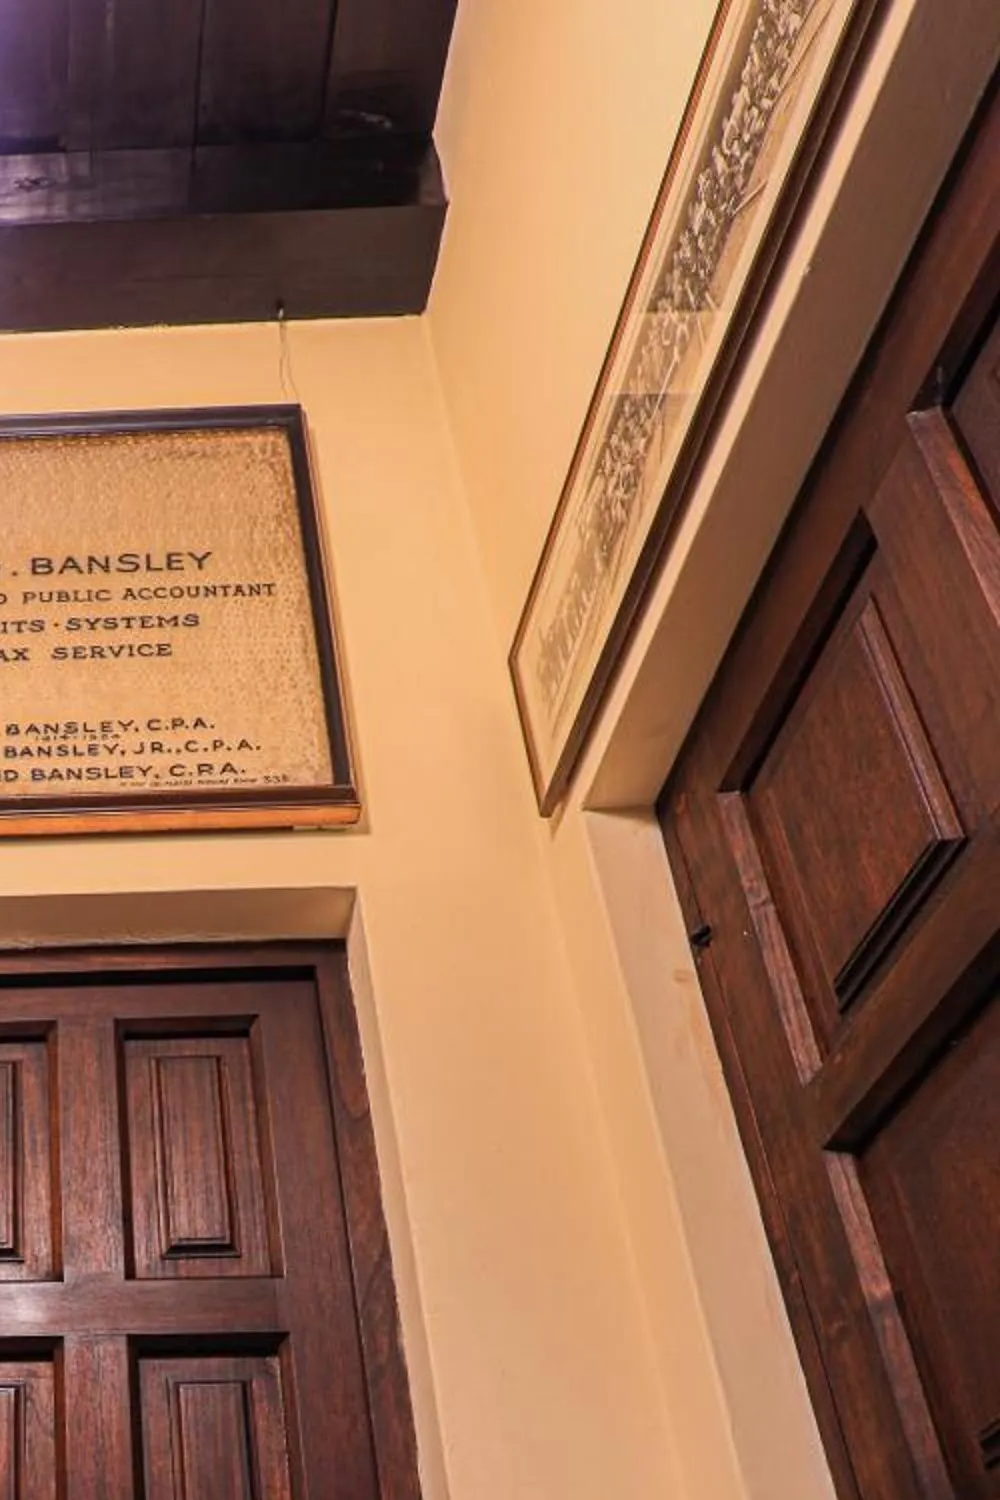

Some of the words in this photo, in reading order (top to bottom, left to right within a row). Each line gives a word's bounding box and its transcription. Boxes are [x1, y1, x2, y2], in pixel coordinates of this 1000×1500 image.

[31, 551, 212, 575] BANSLEY
[22, 589, 112, 604] PUBLIC
[122, 583, 276, 601] ACCOUNTANT
[51, 643, 173, 660] SERVICE
